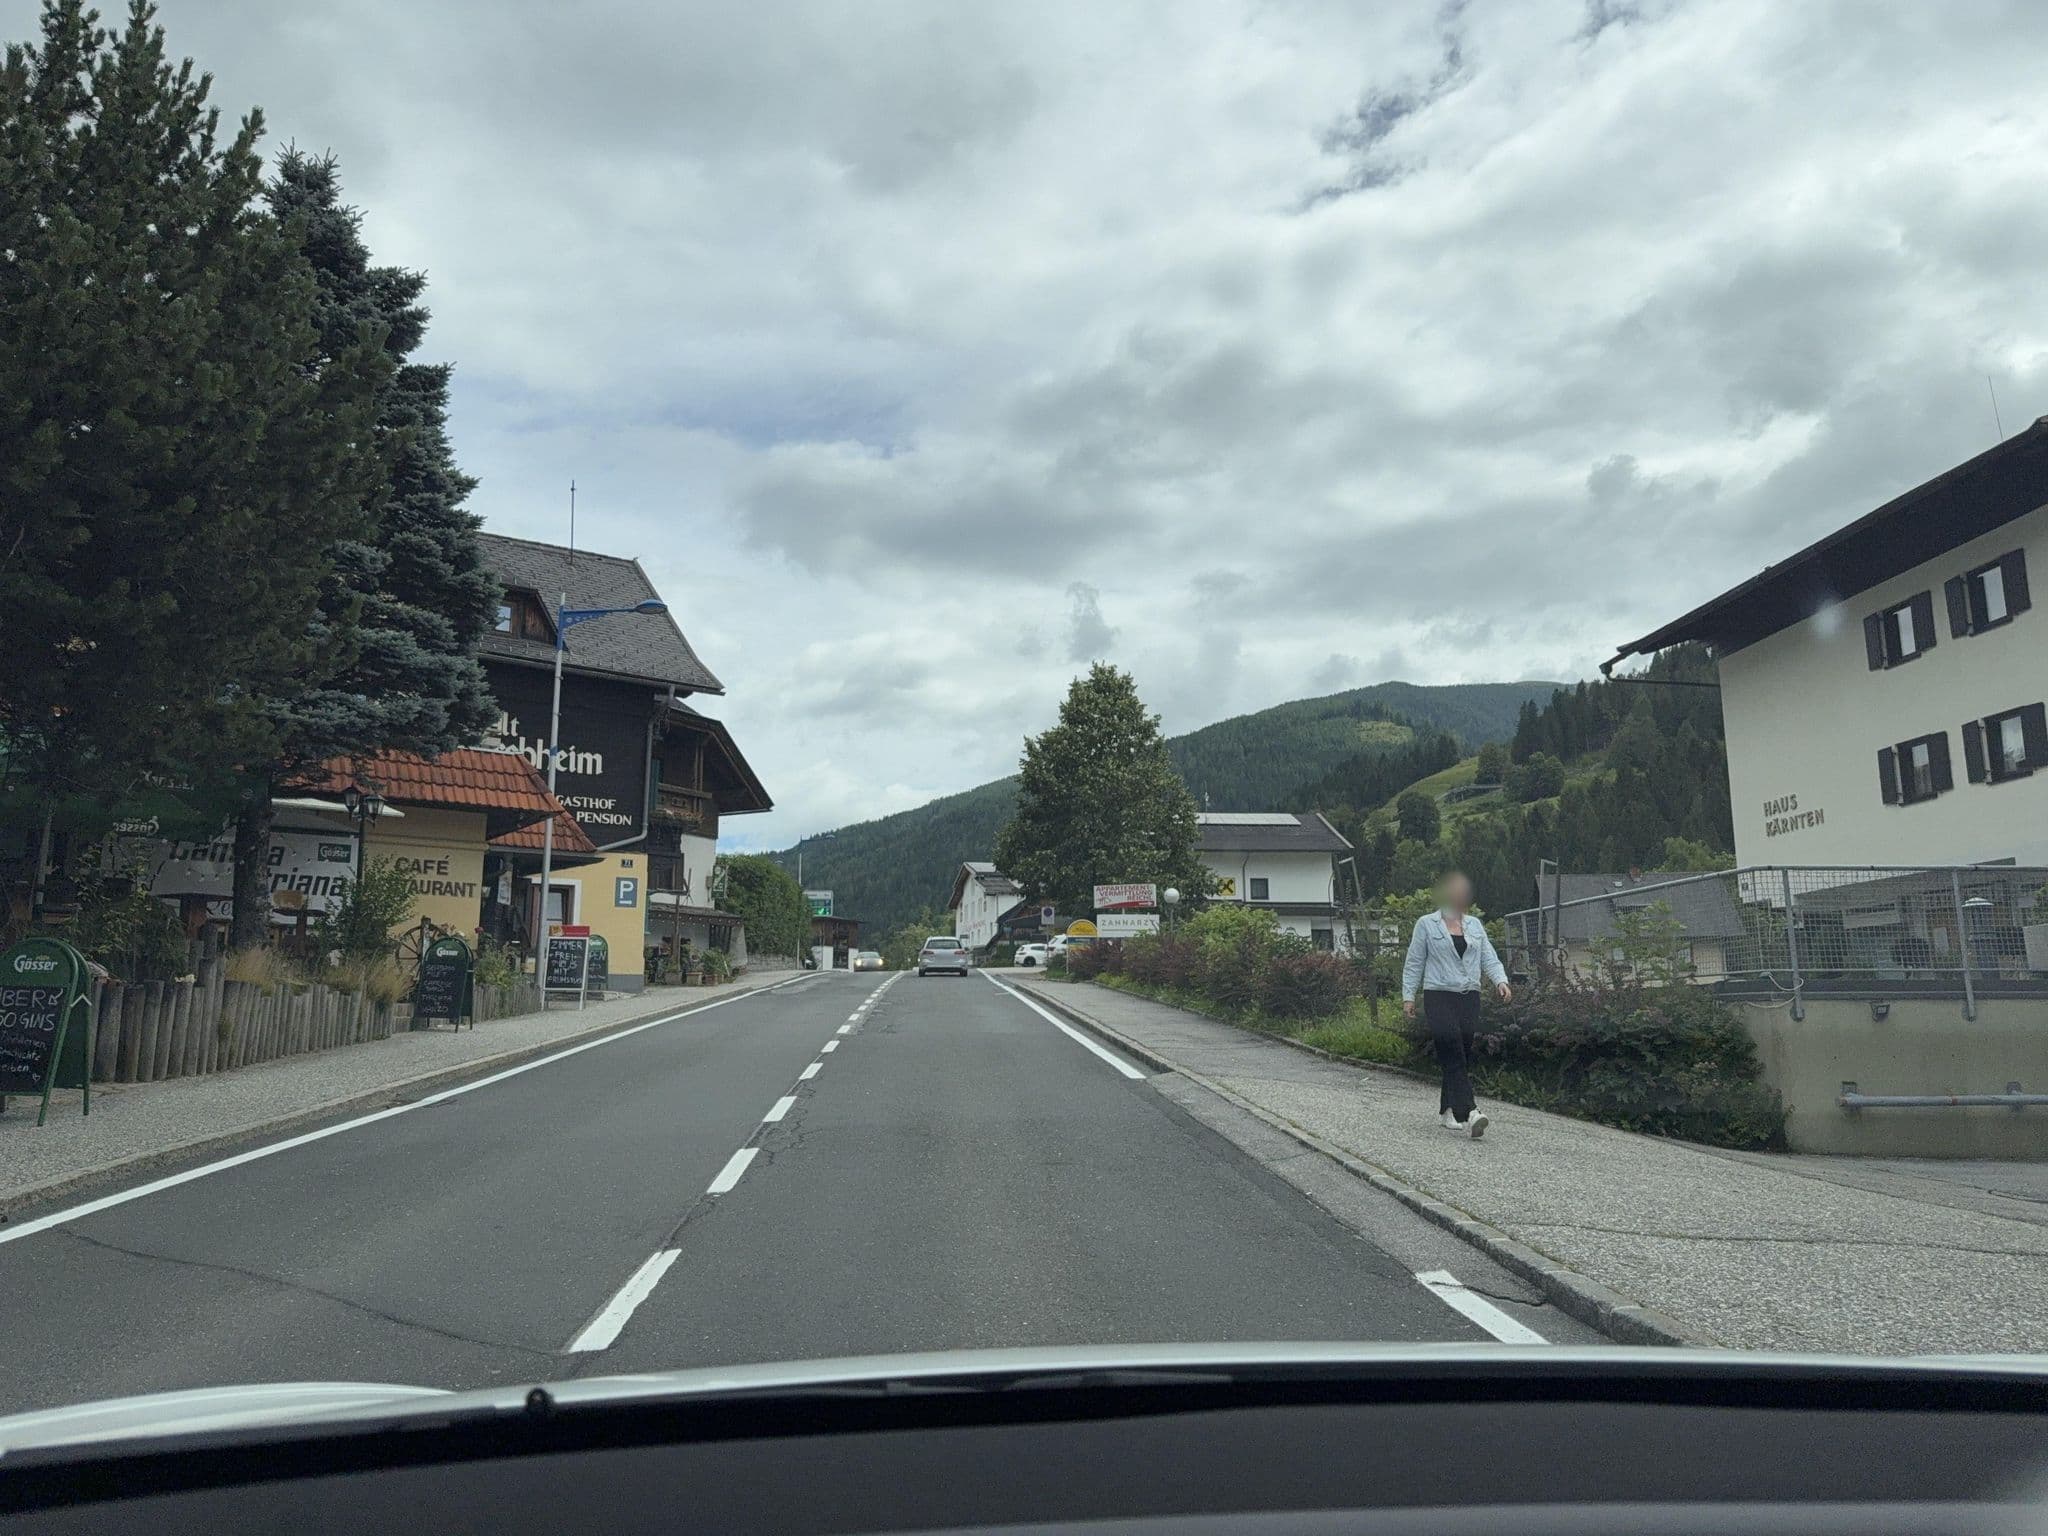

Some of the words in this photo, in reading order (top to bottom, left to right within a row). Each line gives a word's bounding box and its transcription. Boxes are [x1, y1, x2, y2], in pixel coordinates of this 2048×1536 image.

[556, 794, 616, 811] GASTHOF
[1763, 793, 1798, 817] HAUS
[576, 811, 632, 827] PENSION
[1766, 808, 1825, 837] KÄRNTEN
[394, 854, 450, 876] CAFÉ
[619, 880, 634, 899] P
[13, 953, 58, 973] Gösser
[19, 1011, 56, 1031] GINS
